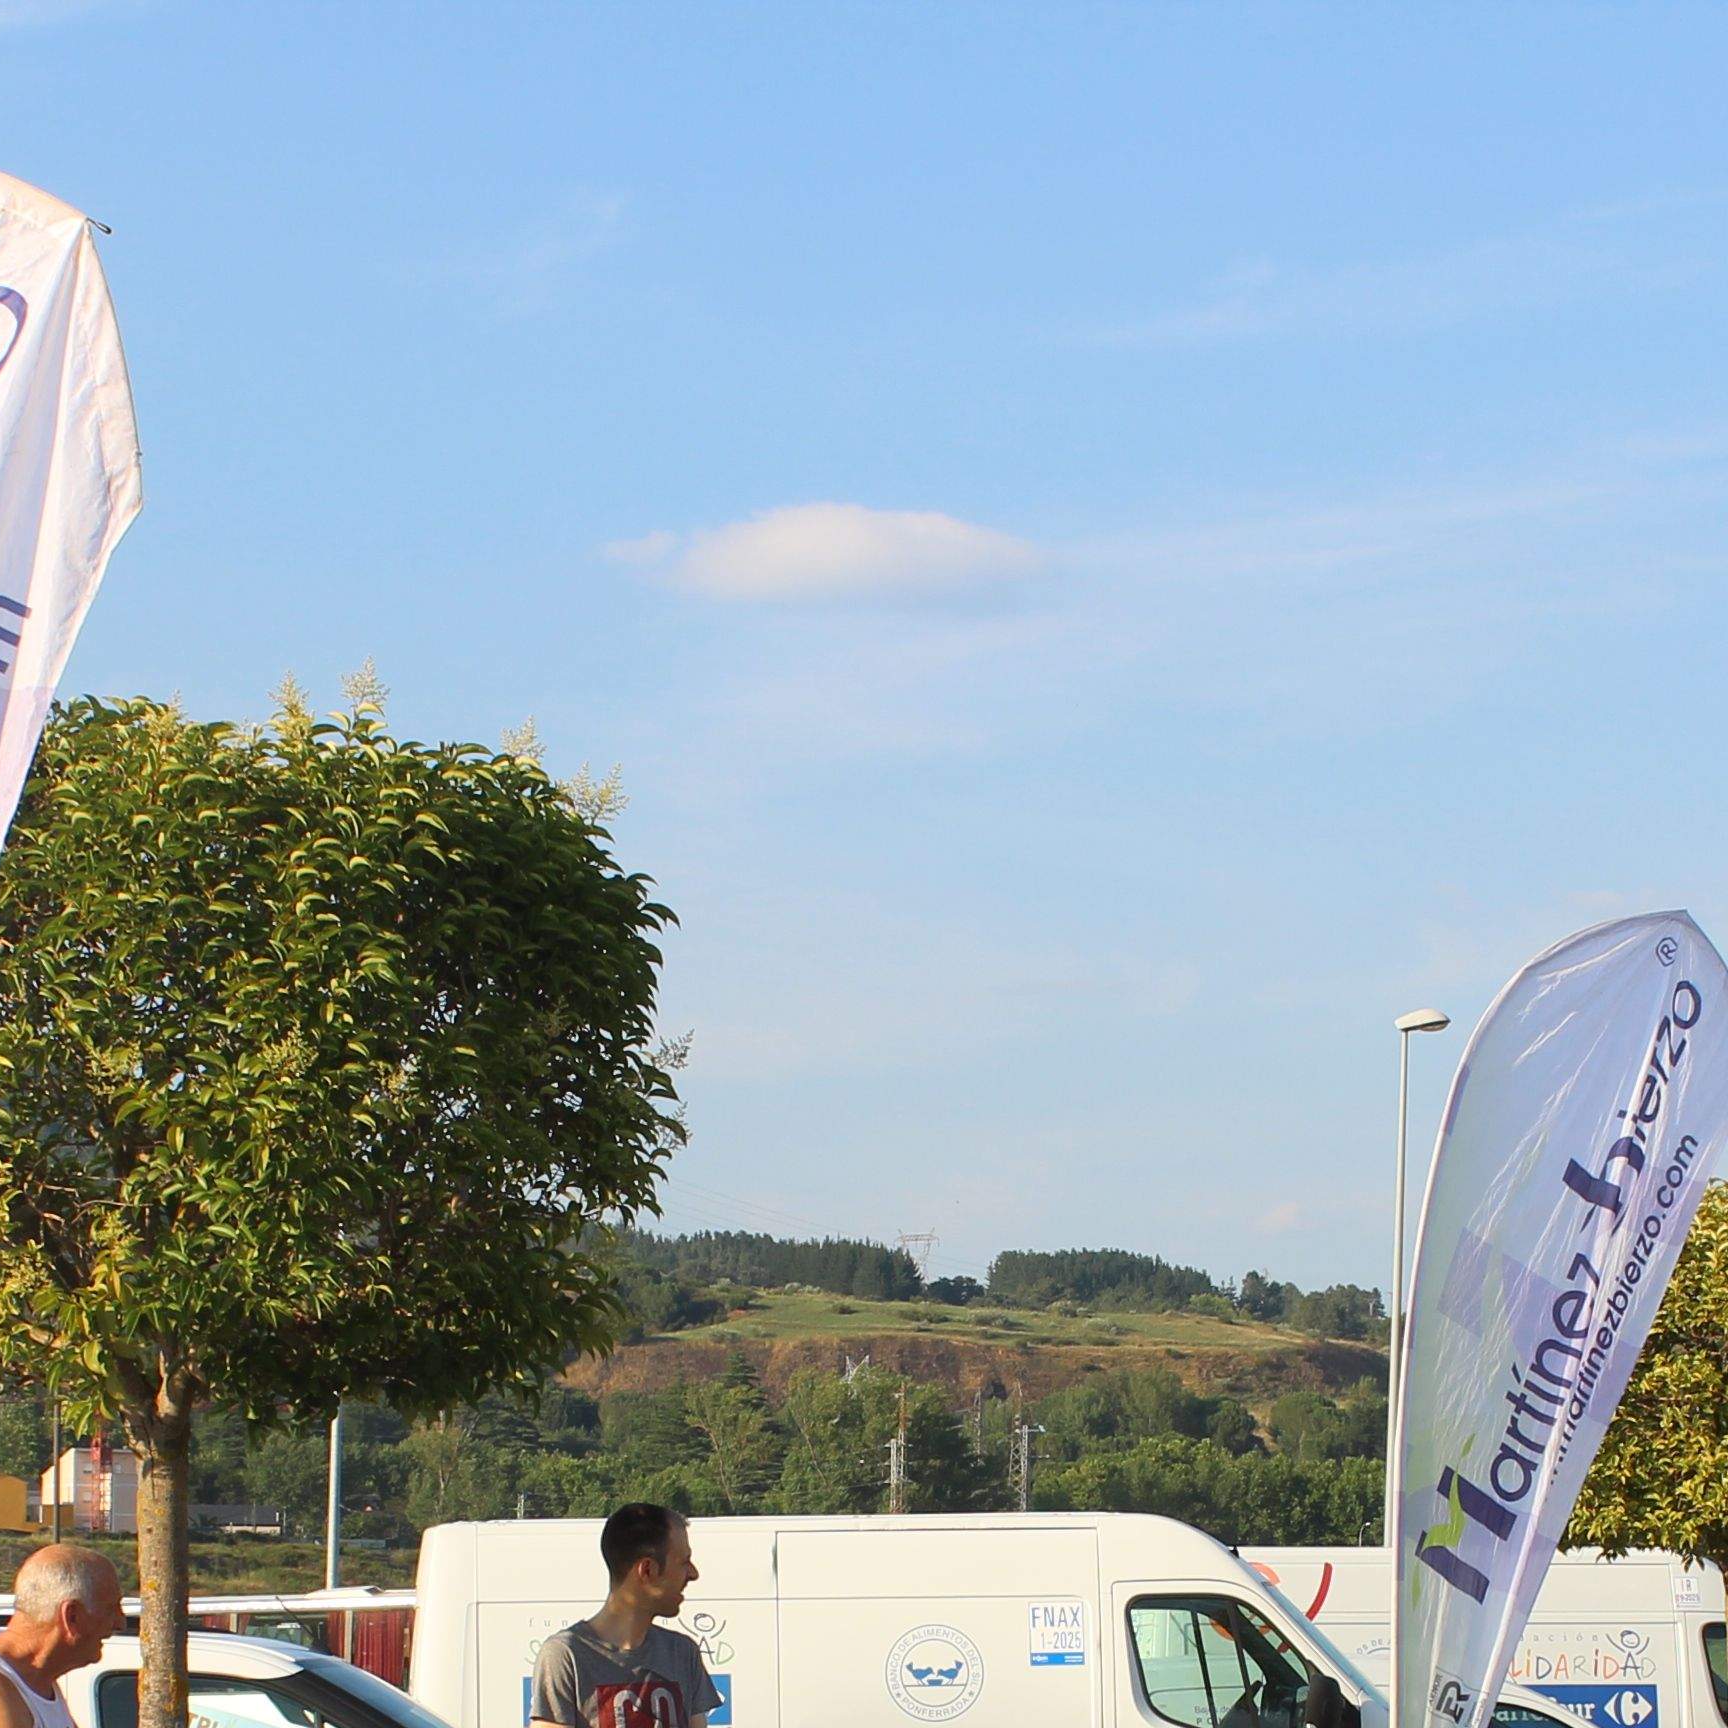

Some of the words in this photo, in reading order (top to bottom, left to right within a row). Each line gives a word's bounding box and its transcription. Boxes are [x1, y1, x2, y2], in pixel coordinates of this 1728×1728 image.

[1549, 1133, 1699, 1486] artinezbierzo.com
[1031, 1606, 1080, 1628] FNAX
[1041, 1631, 1081, 1649] 1-2025
[889, 1652, 900, 1690] BANCO
[899, 1639, 912, 1652] DE
[912, 1628, 970, 1652] ALIMENTOS
[964, 1648, 979, 1668] DEL
[901, 1696, 970, 1718] PONFERRADA
